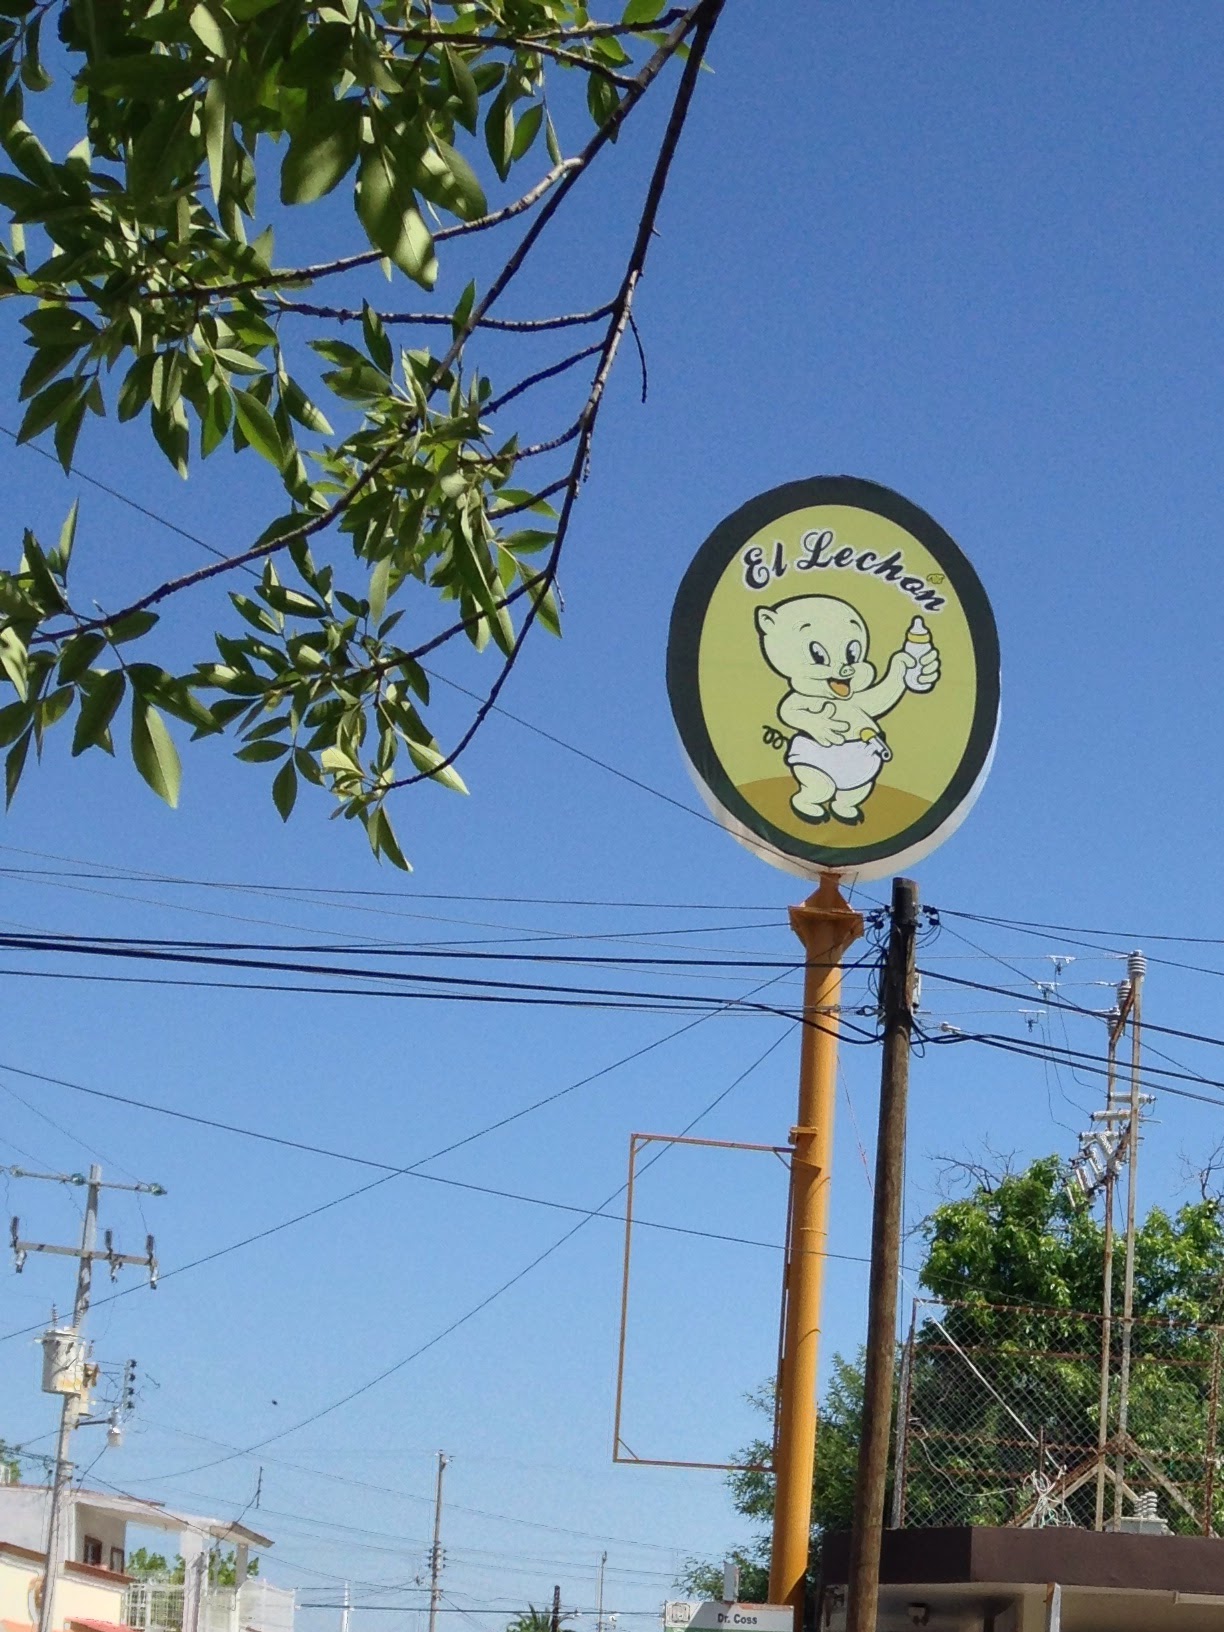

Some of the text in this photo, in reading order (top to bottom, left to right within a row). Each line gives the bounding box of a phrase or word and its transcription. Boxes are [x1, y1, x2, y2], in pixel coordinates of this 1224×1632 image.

[743, 530, 946, 612] El Lechon
[717, 1613, 758, 1625] Dr. Coss
